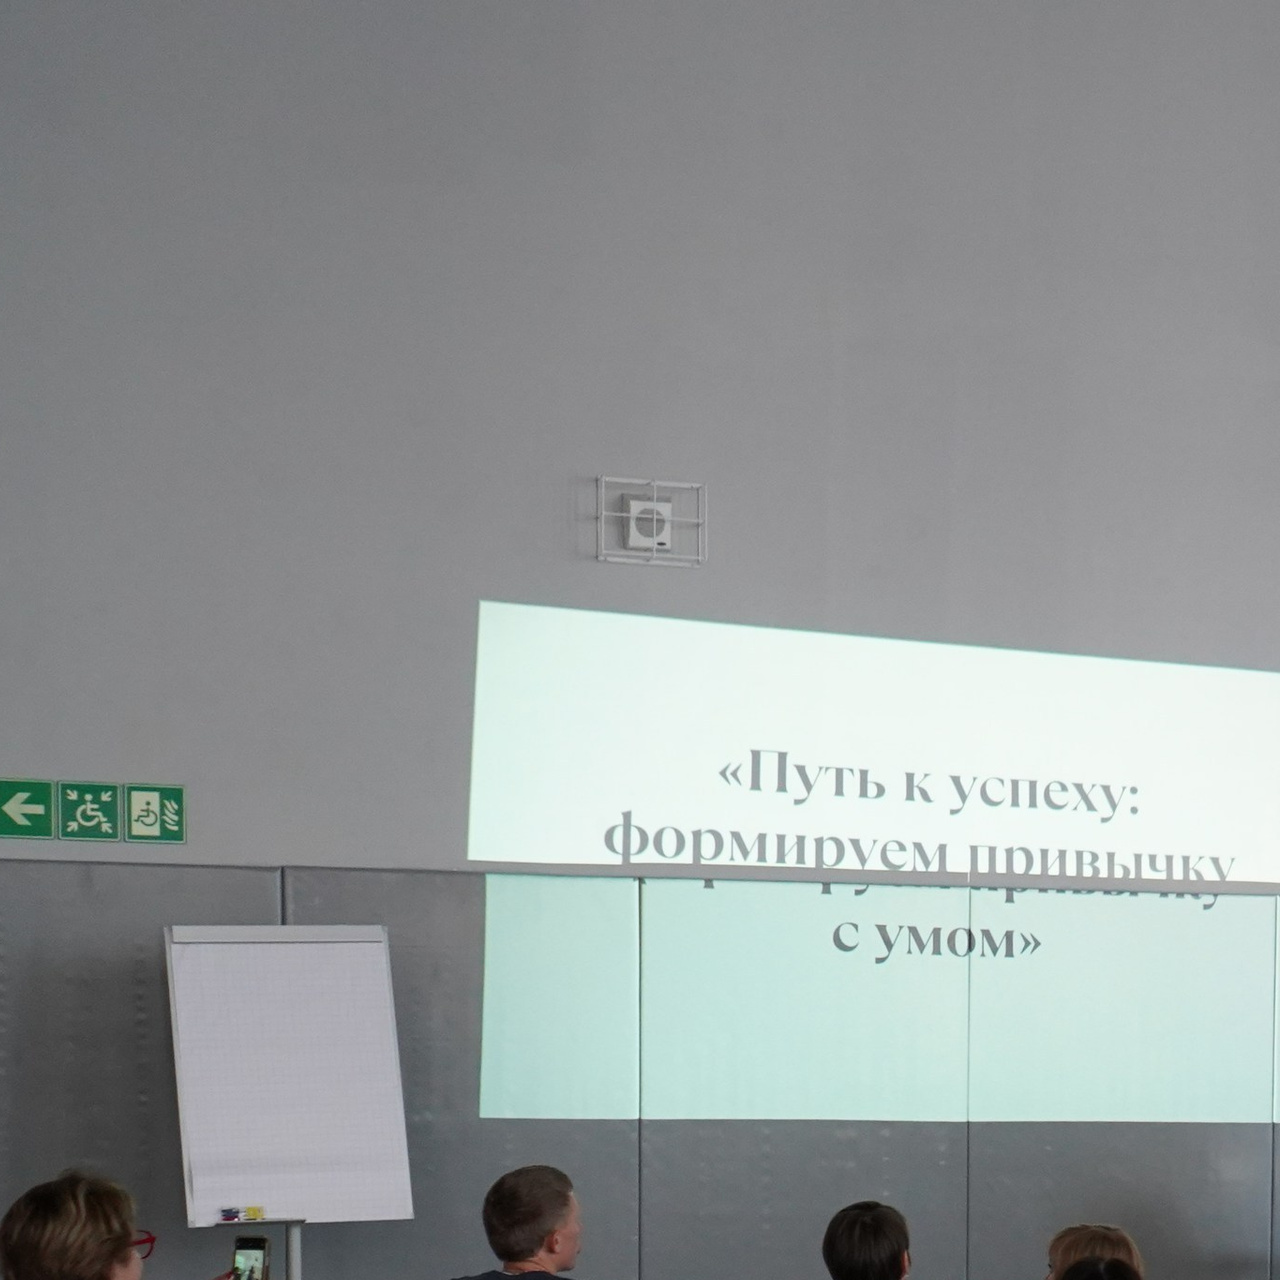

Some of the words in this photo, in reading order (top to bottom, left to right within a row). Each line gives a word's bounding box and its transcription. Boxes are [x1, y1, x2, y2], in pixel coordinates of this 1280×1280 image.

[718, 748, 886, 806] «Путь
[904, 771, 934, 803] к
[948, 774, 1140, 824] успеху:
[832, 921, 860, 953] с
[874, 923, 1043, 965] умом»
